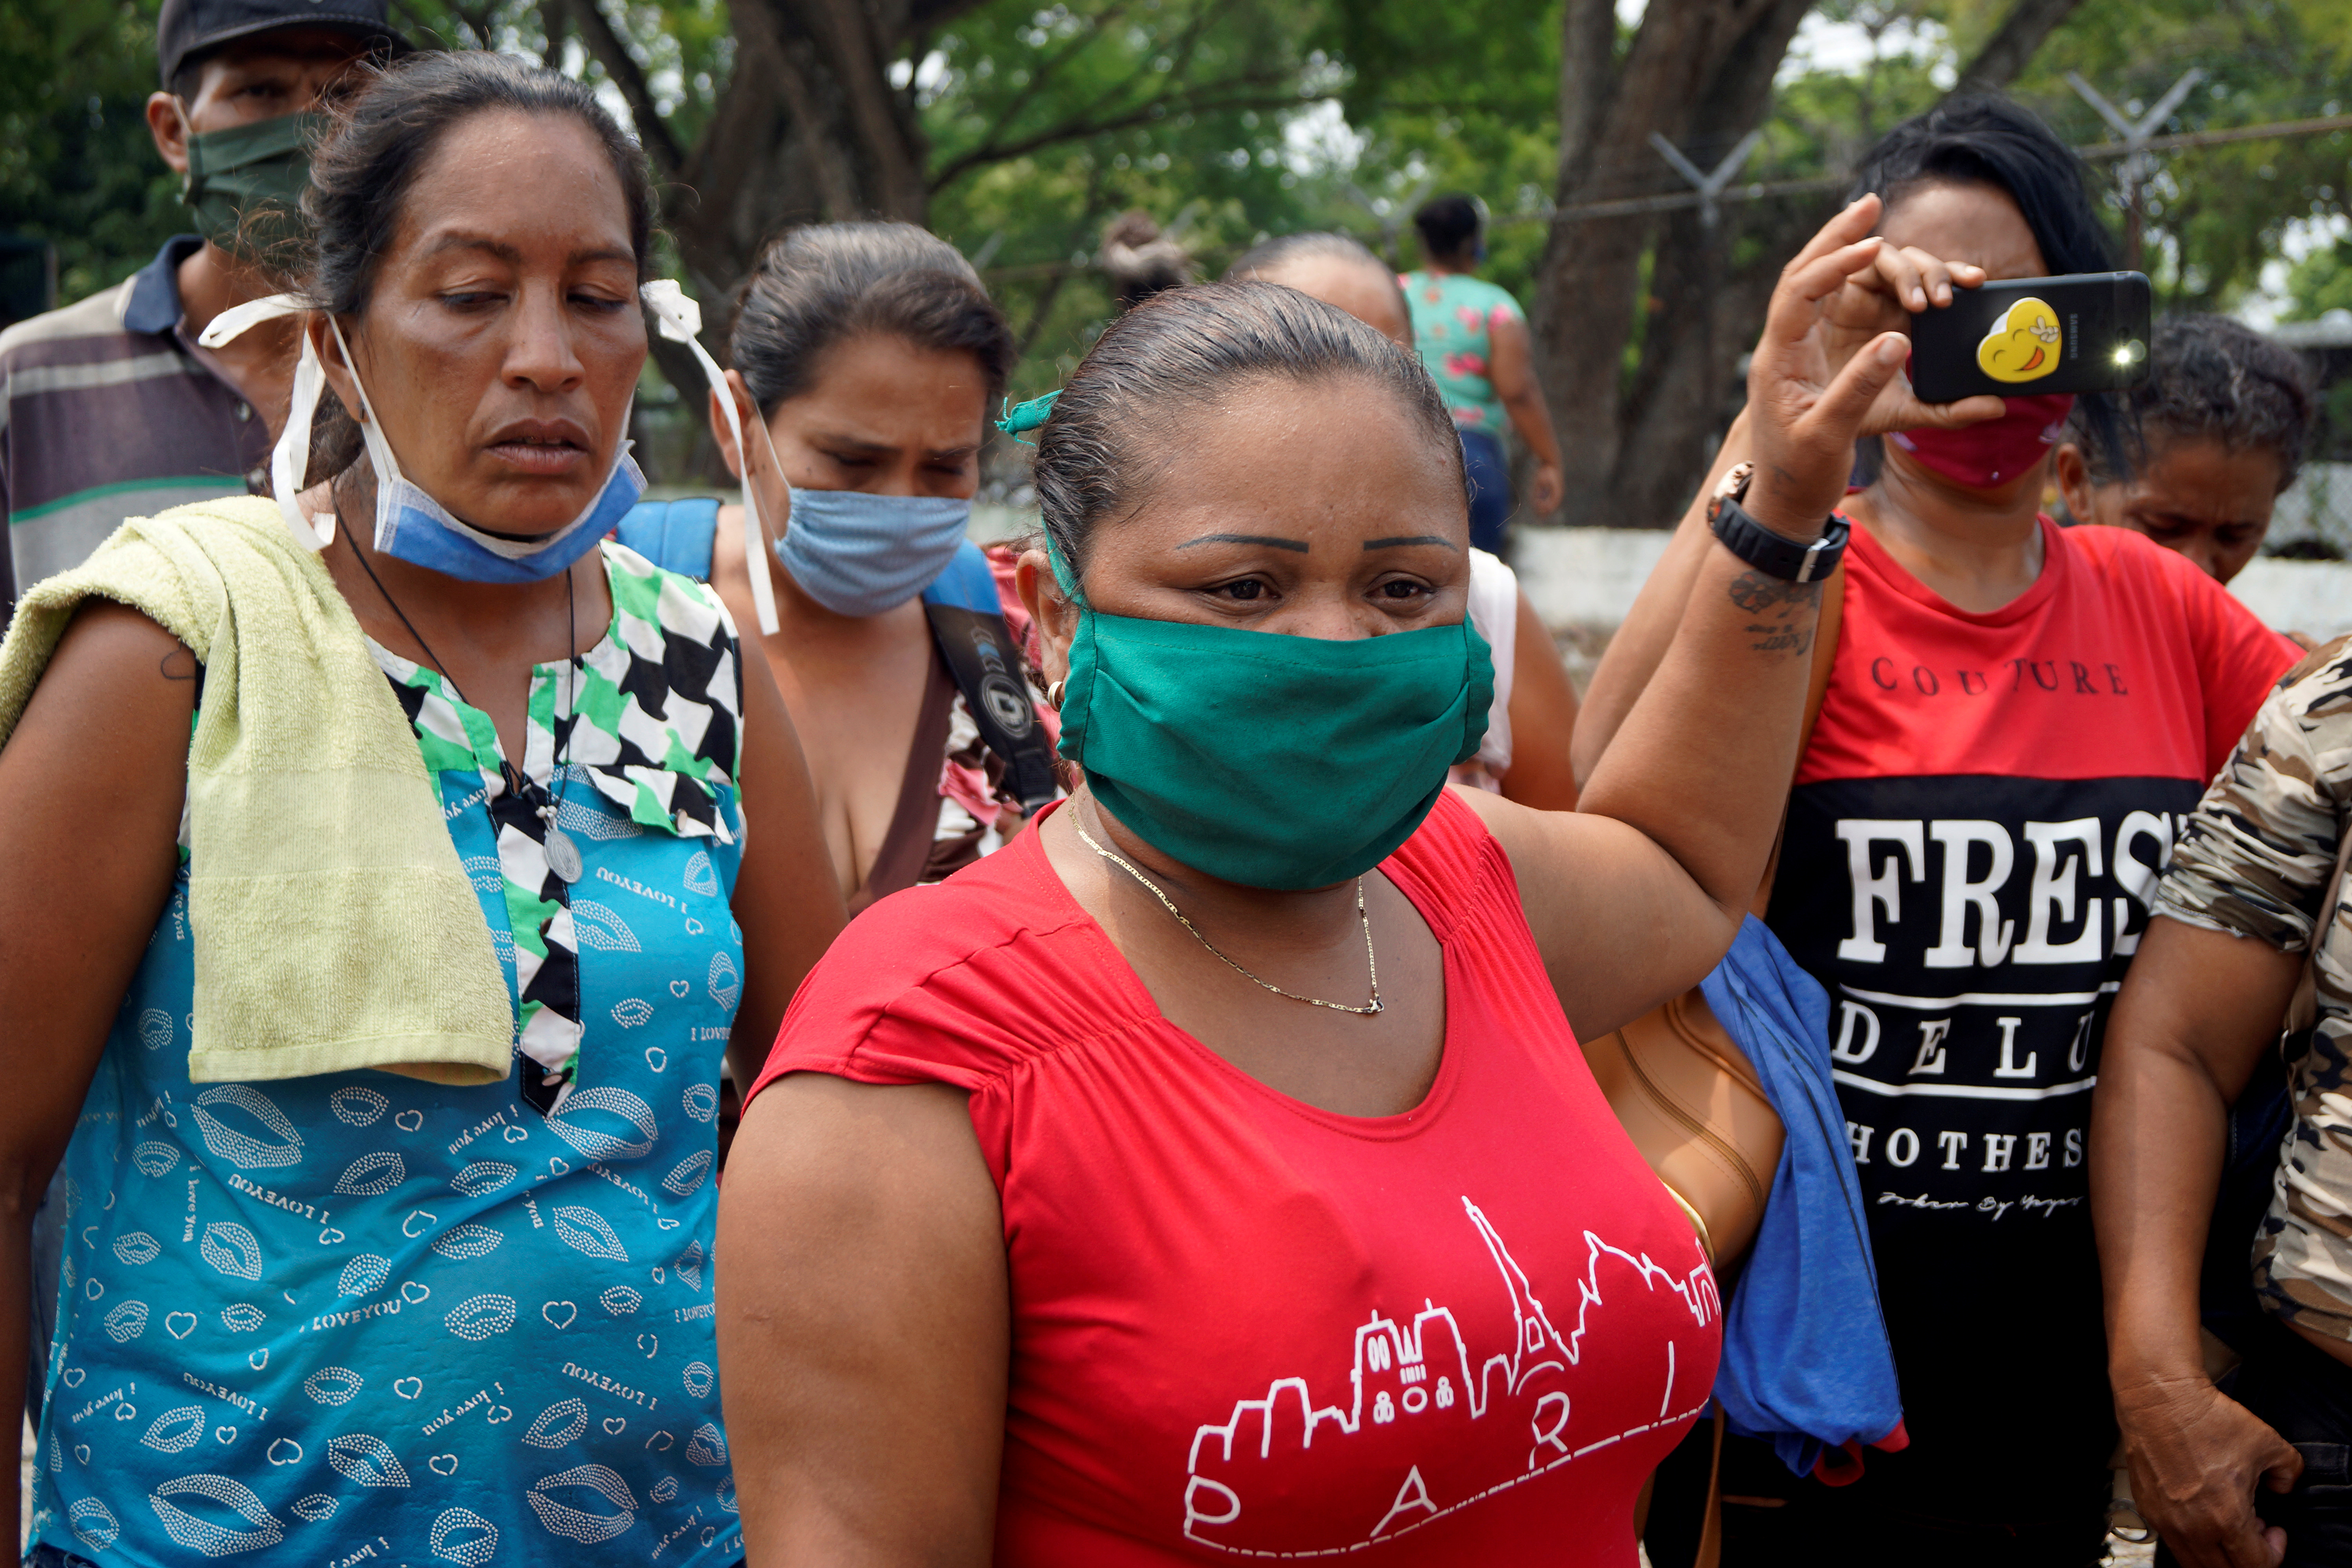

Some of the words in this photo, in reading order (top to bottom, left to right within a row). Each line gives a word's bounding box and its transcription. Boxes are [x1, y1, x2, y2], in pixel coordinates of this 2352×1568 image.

[2070, 313, 2078, 360] SAMSUNG
[1871, 656, 2129, 697] COUTURE
[595, 866, 676, 908] LOVEYOU
[1835, 809, 2188, 968] FRES
[681, 902, 688, 915] I
[691, 1027, 697, 1042] I
[228, 1173, 315, 1219] LOVEYOU
[587, 1162, 649, 1206] LOVEYO
[319, 1210, 330, 1225] I
[653, 1203, 659, 1214] I
[312, 1299, 402, 1331] LOVEYOU
[183, 1372, 257, 1415] LOVEYOU
[562, 1362, 646, 1405] LOVEYOU
[648, 1397, 658, 1410] I
[258, 1407, 269, 1421] I
